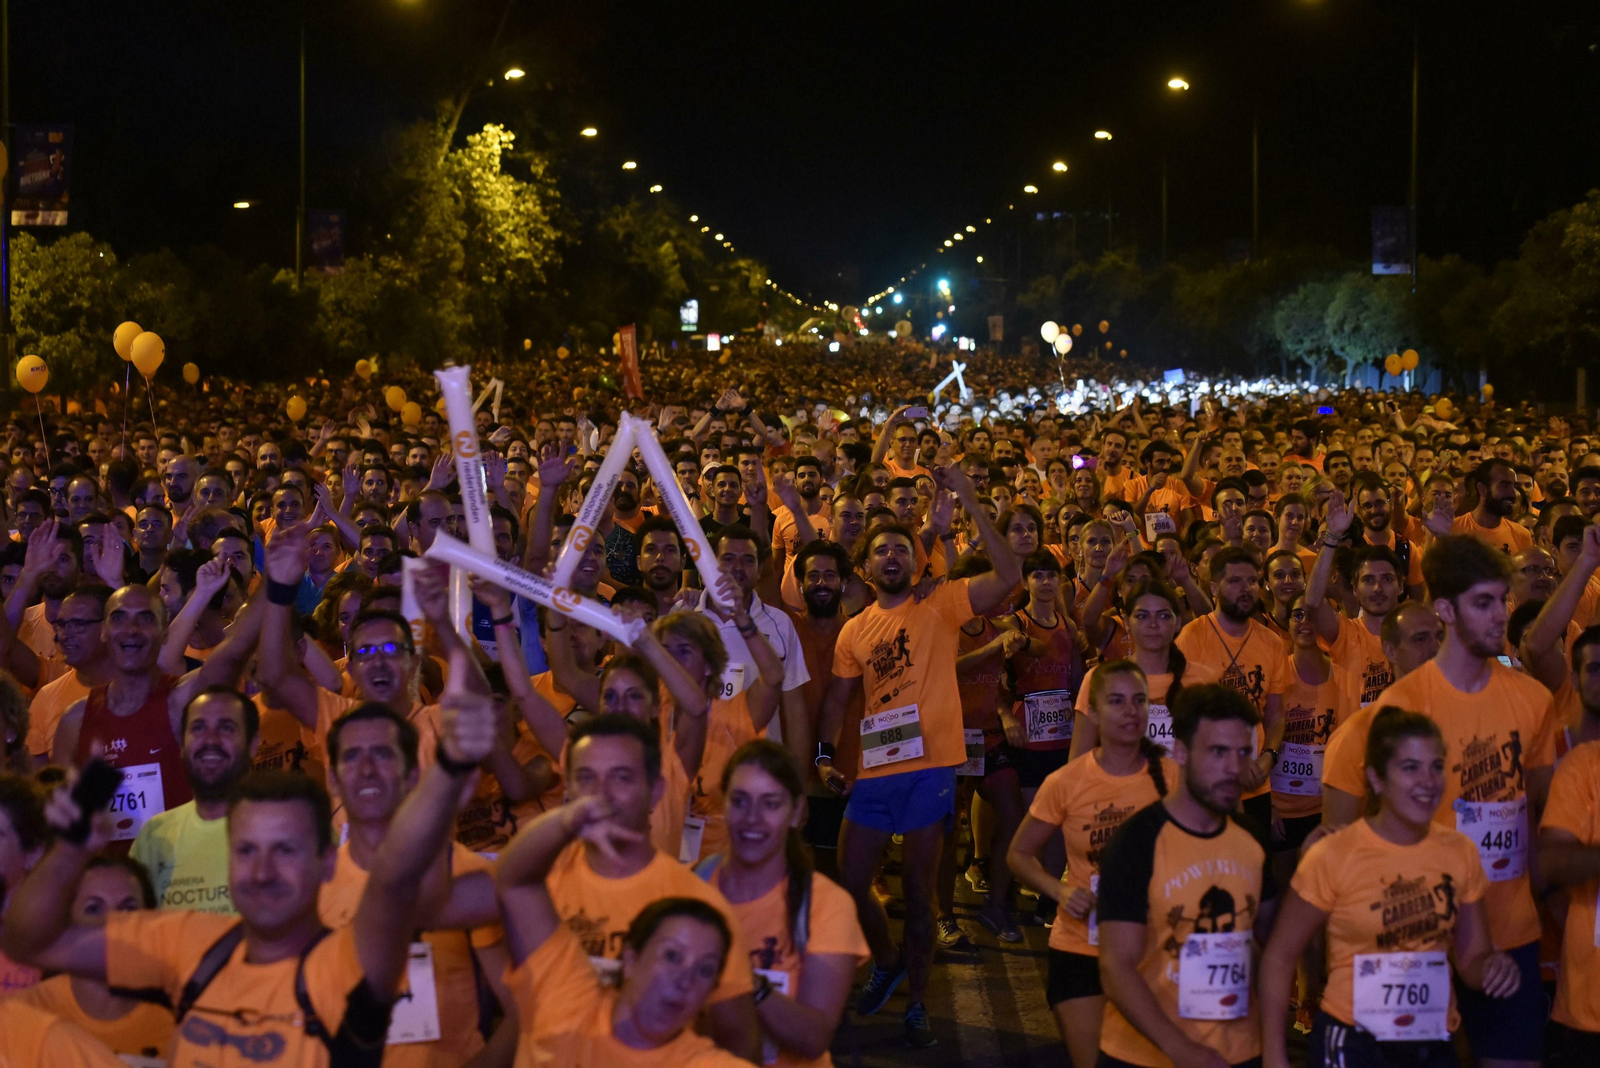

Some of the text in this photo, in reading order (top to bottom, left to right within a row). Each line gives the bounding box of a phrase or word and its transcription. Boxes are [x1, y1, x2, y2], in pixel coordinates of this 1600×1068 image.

[463, 461, 480, 523] nederlanden
[581, 483, 603, 523] nationale
[590, 473, 618, 526] nederlanden
[1039, 710, 1064, 724] 8695
[880, 727, 903, 745] 688
[1282, 760, 1313, 777] 8308
[1460, 751, 1502, 788] CARRERA
[110, 790, 147, 813] 2761
[1480, 827, 1520, 851] 4481
[1382, 892, 1436, 926] CARRERA
[1376, 911, 1439, 949] NOCTURNA
[1207, 962, 1246, 985] 7764
[1382, 983, 1430, 1005] 7760
